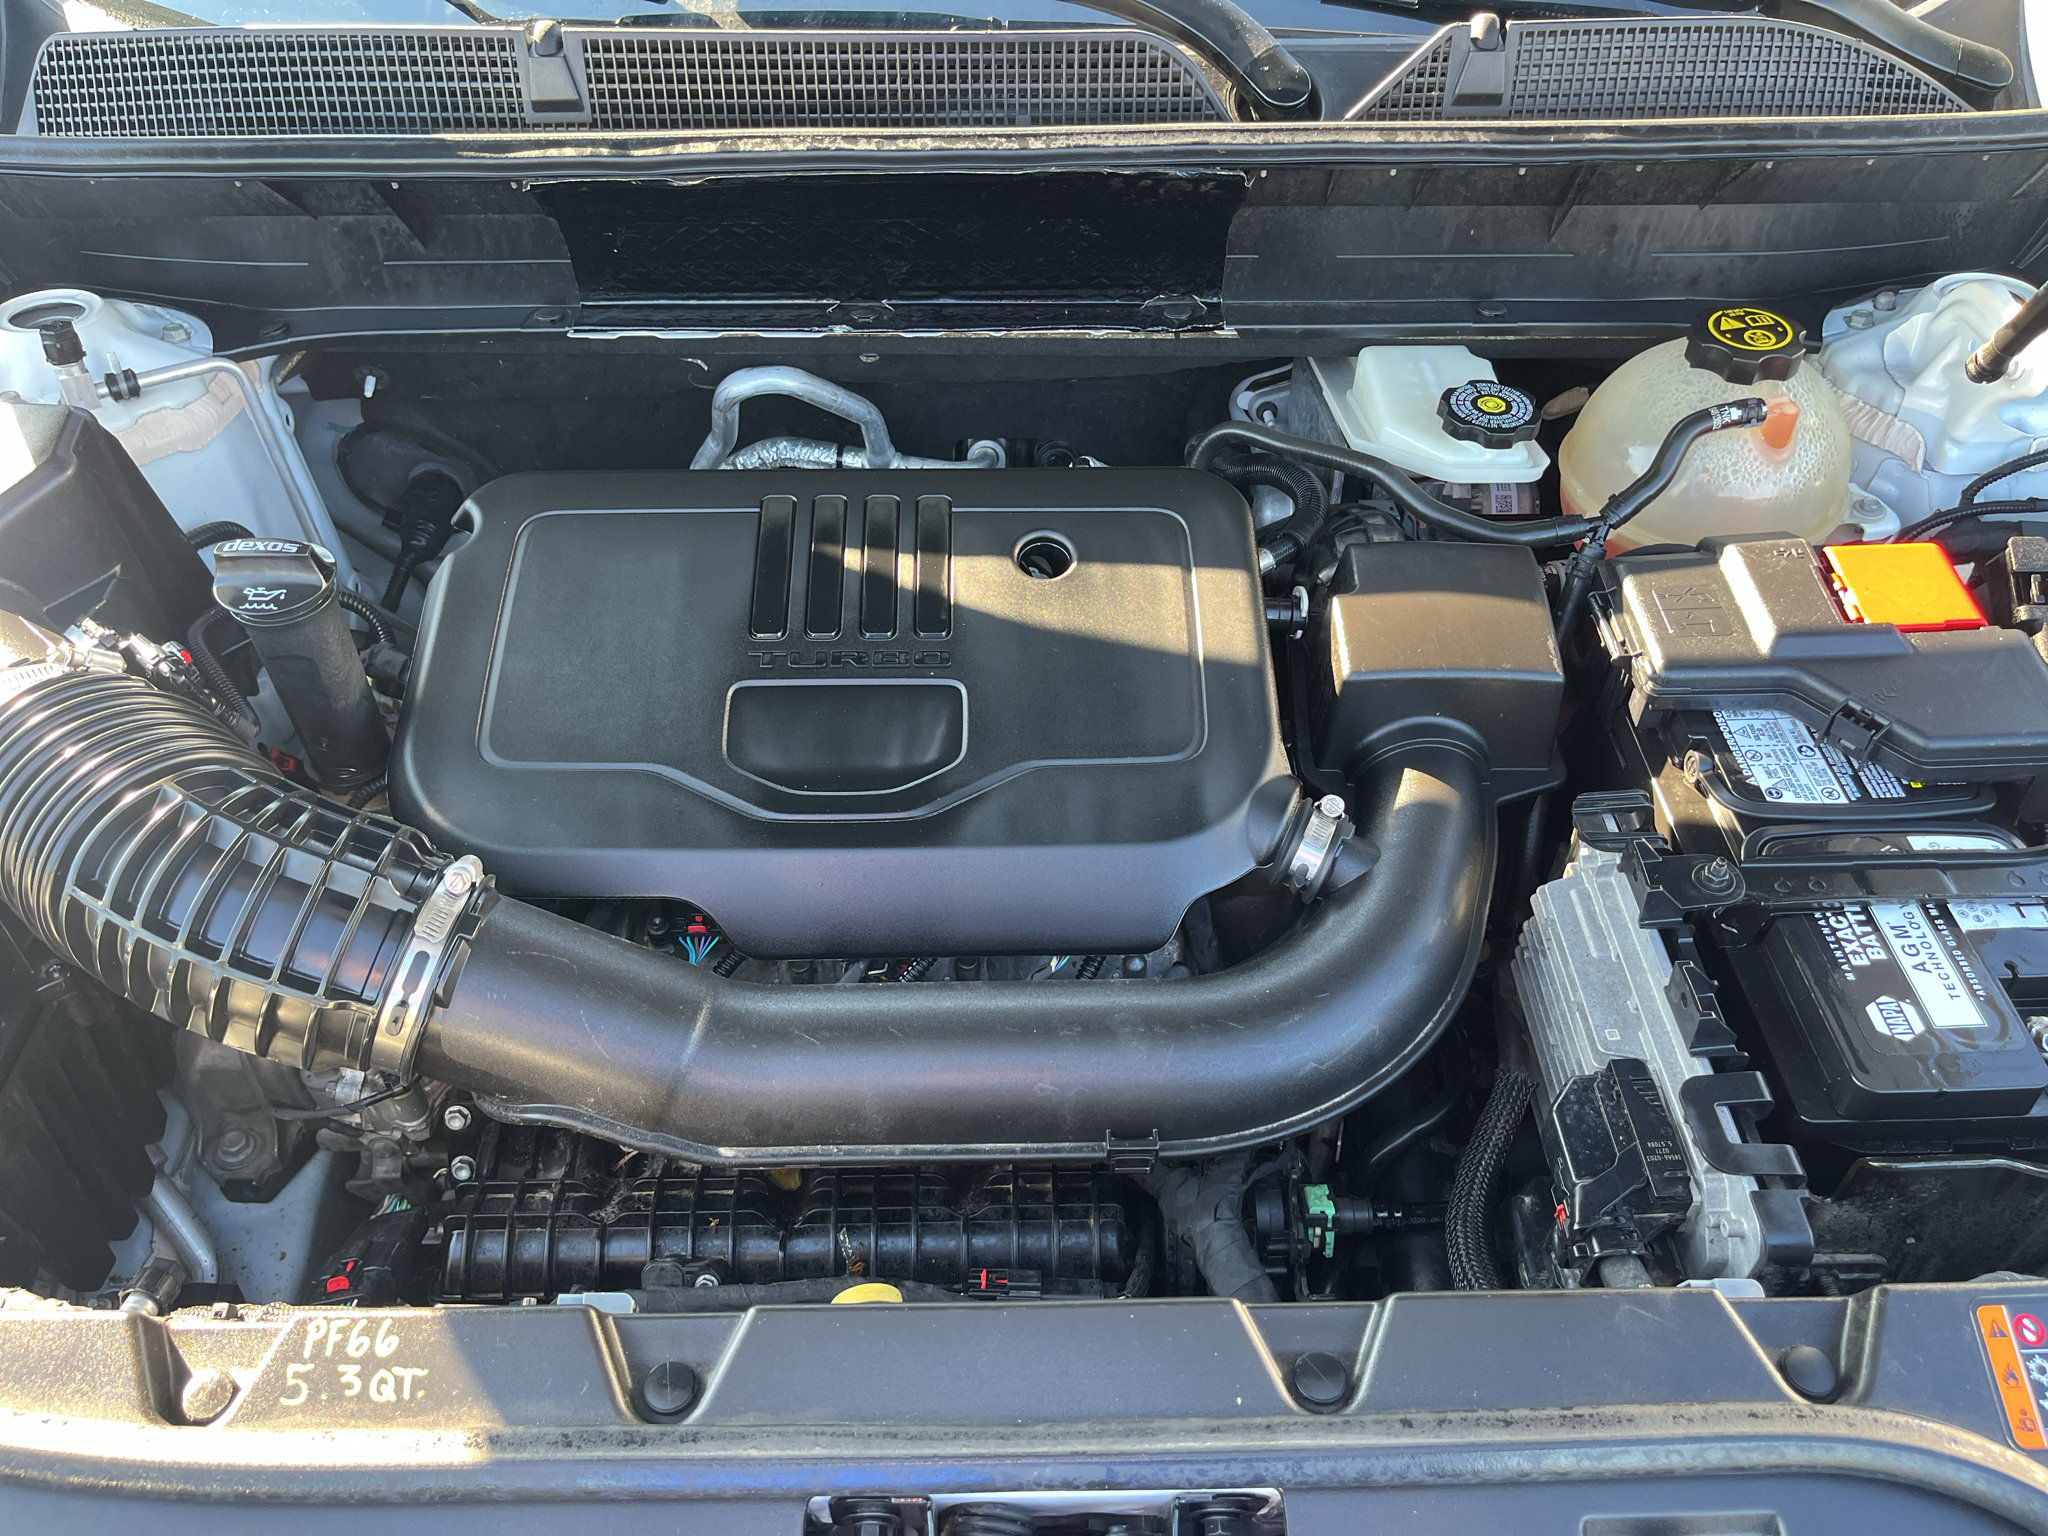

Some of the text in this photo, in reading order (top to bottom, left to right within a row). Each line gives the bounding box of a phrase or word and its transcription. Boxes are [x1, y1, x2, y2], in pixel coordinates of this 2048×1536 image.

[223, 538, 298, 553] dexos
[748, 650, 951, 668] TURBO
[1713, 709, 1752, 776] DANGER/POISO
[1827, 912, 1871, 966] EXAC
[1888, 924, 1933, 974] AGM
[1934, 919, 1957, 947] GLASS
[1873, 999, 1917, 1038] NAPA
[303, 1318, 400, 1359] PF66
